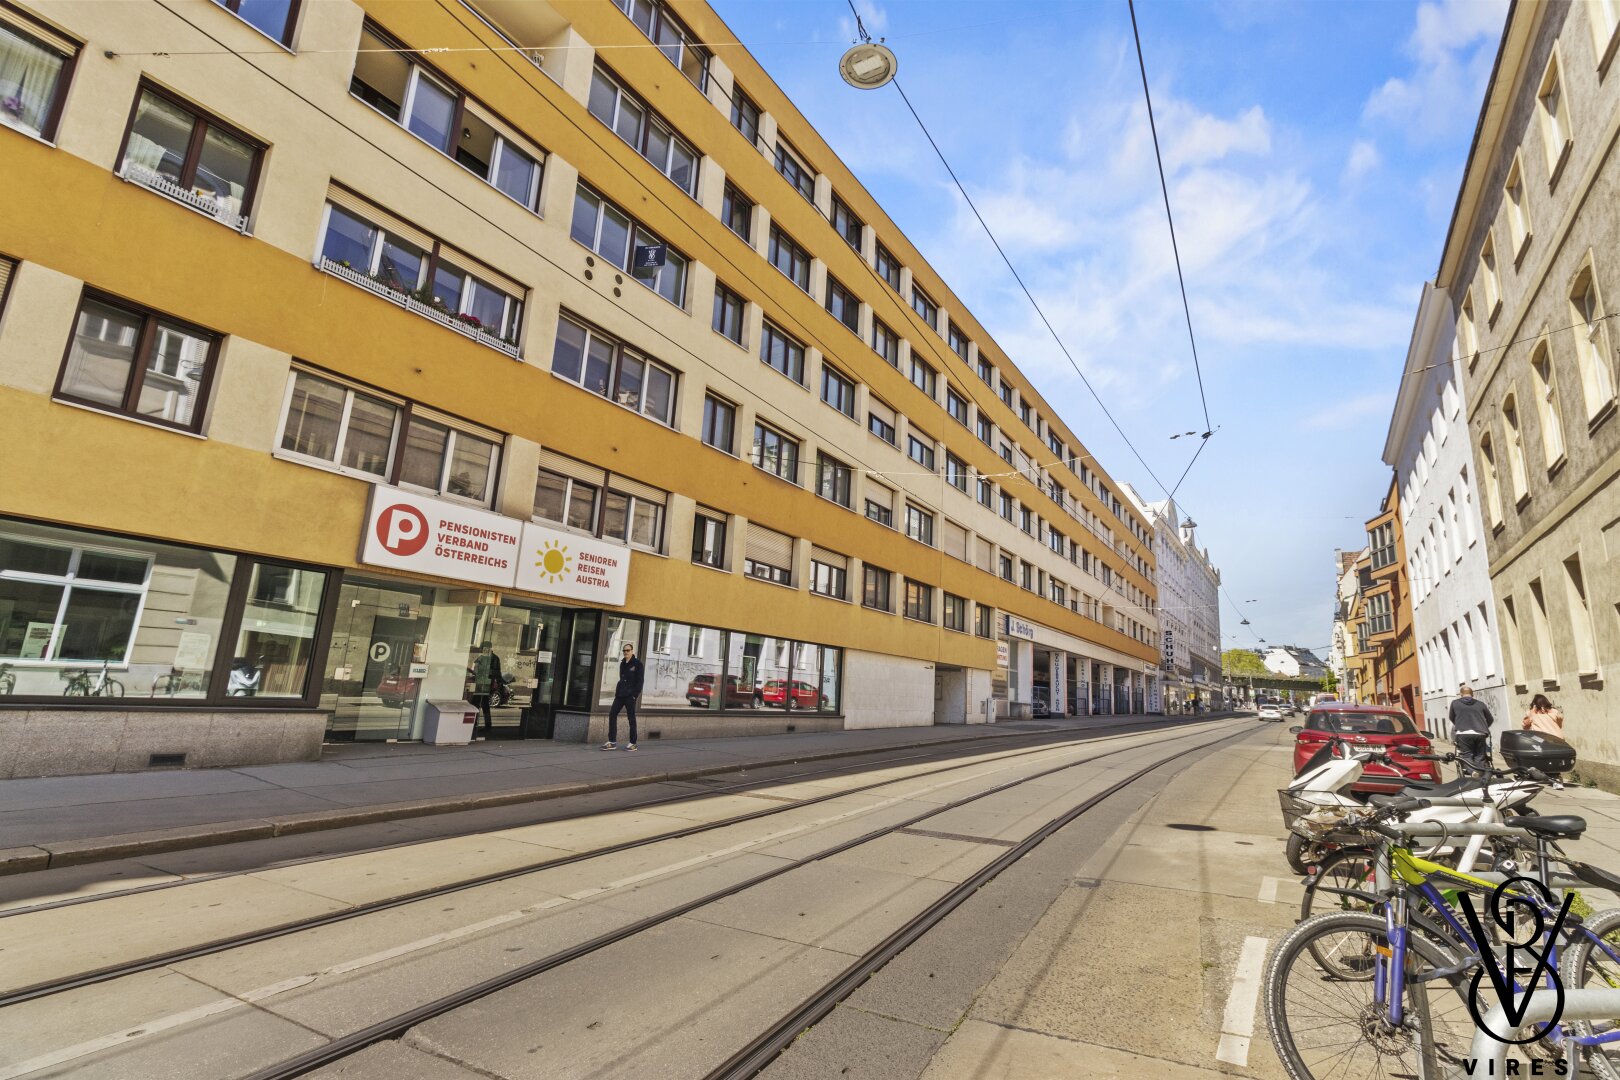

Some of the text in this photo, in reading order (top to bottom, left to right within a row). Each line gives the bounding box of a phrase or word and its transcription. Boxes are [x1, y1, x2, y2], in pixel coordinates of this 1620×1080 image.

[439, 519, 517, 546] PENSIONISTEN
[437, 533, 489, 552] VERBAND
[434, 545, 508, 569] ÖSTERREICHS
[579, 551, 618, 568] SENIOREN
[577, 563, 606, 576] REISEN
[576, 574, 610, 589] AUSTRIA
[1165, 630, 1175, 671] SCHUHE
